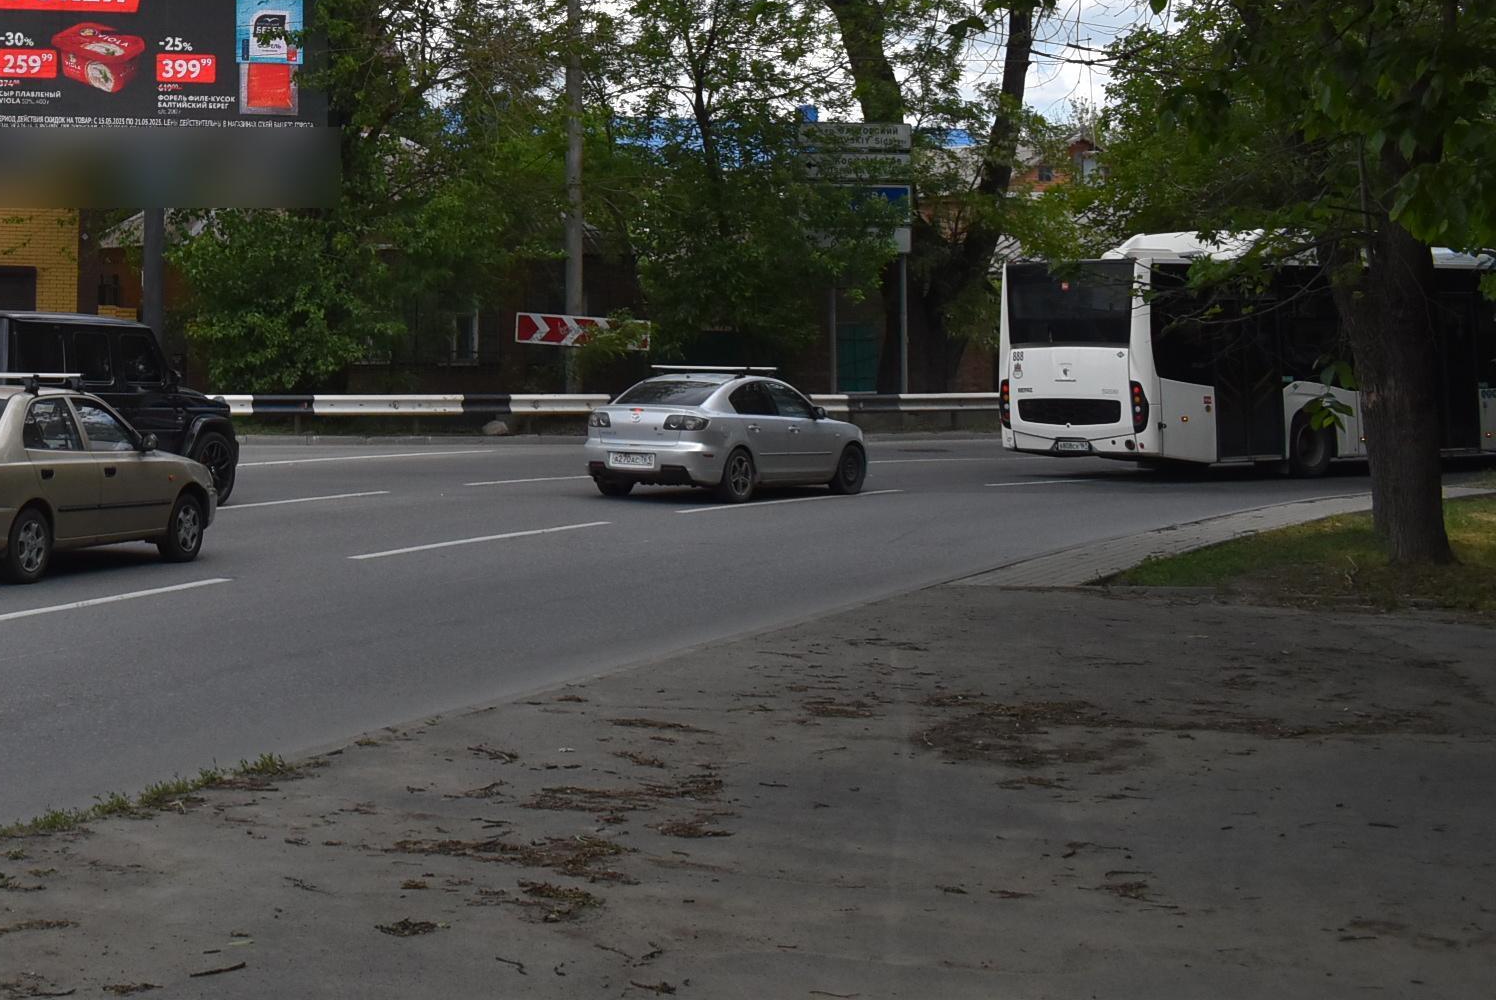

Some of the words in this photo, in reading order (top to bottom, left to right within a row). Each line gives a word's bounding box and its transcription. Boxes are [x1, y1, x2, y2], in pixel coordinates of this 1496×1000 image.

[0, 32, 34, 47] -30%
[98, 34, 129, 47] VIOLA
[159, 36, 193, 52] -25%
[15, 90, 62, 98] ПЛАВЛЕНЫЙ
[187, 95, 236, 103] ФИЛЕ-КУСОК
[157, 101, 208, 109] БАЛТИЙСКИЙ
[208, 102, 229, 110] БЕРЕГ
